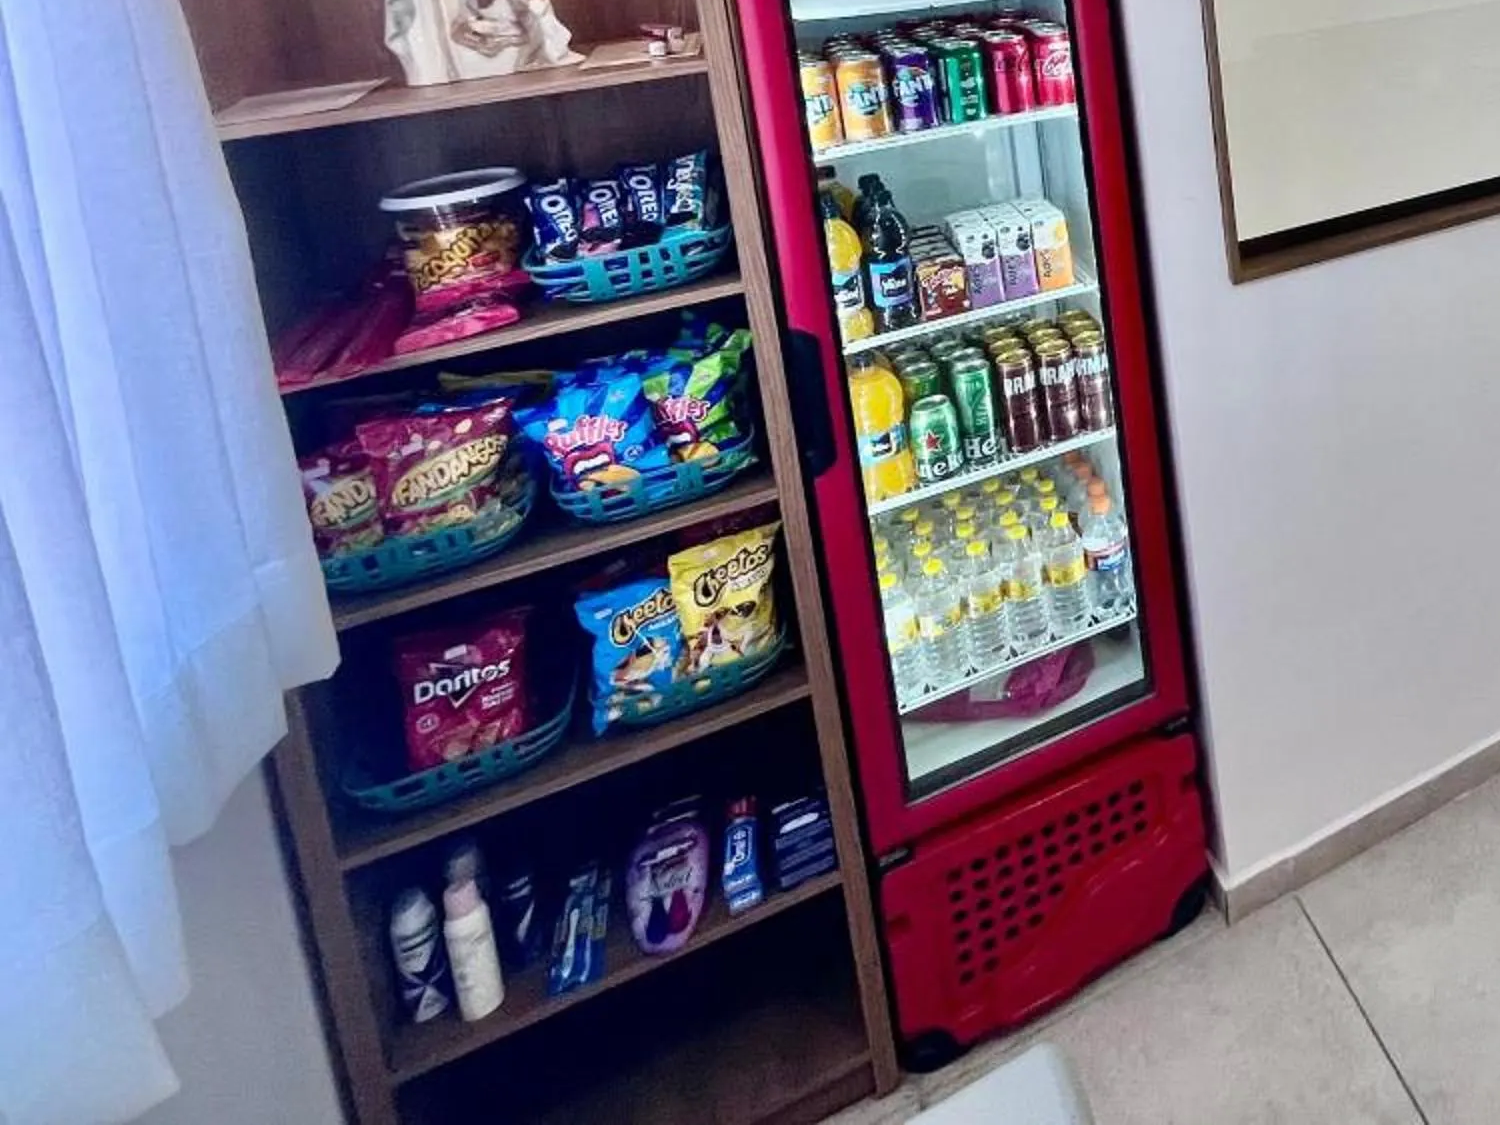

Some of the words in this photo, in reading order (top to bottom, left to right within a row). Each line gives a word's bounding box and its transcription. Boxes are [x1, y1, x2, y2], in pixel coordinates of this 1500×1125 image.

[392, 435, 508, 507] FANDANGOS
[694, 545, 772, 607] Cheetos
[414, 659, 511, 705] Doritos
